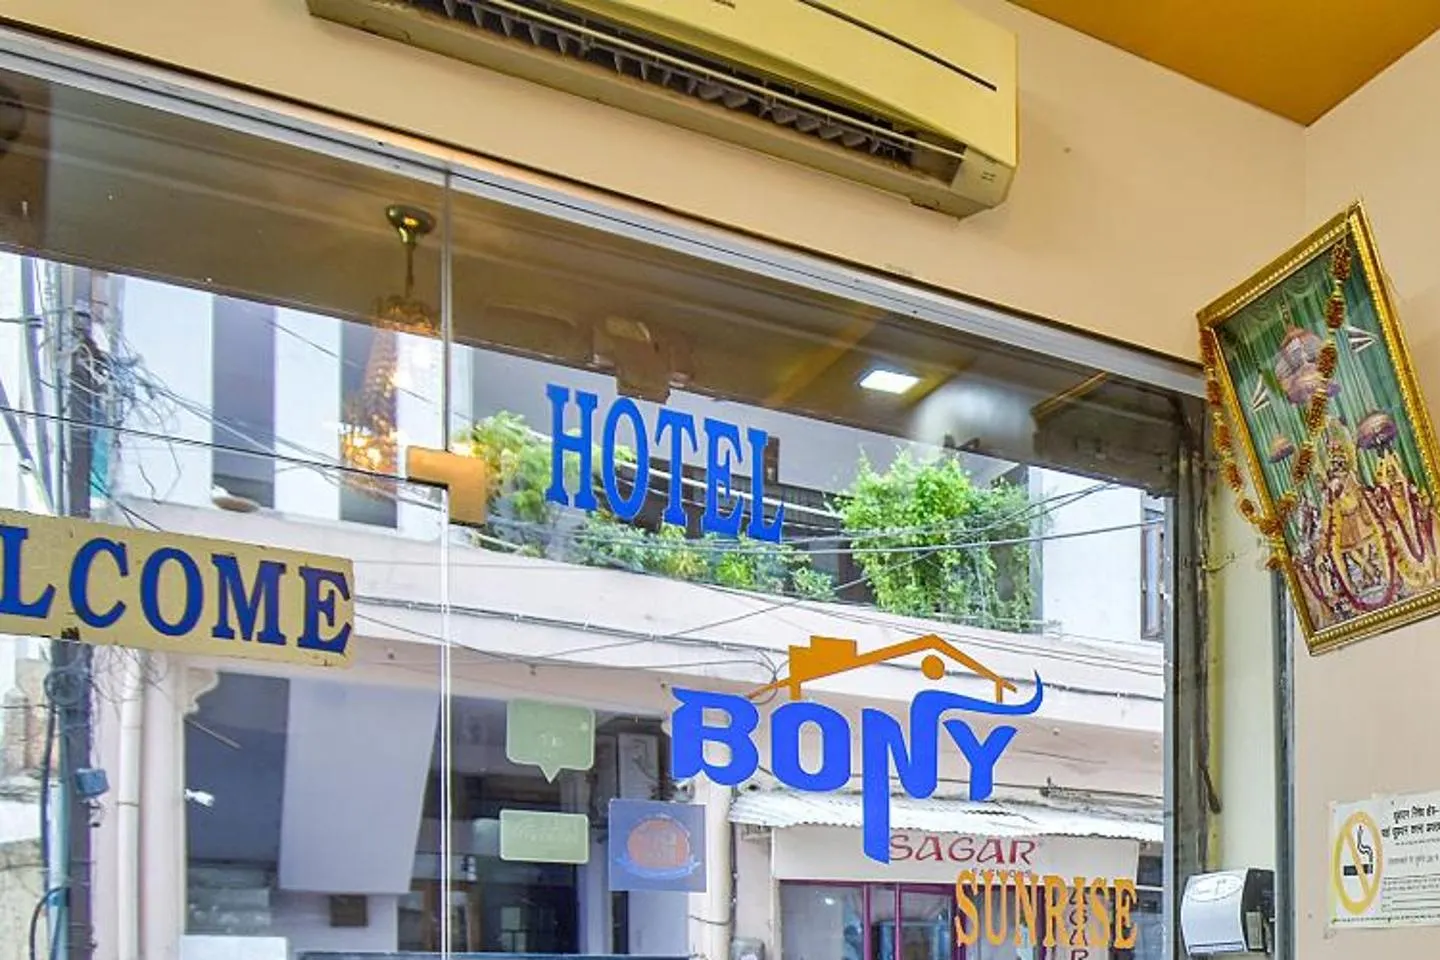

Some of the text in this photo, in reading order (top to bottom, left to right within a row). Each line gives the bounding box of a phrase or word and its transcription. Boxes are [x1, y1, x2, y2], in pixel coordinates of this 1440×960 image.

[545, 383, 785, 544] HOTEL
[0, 523, 353, 655] LCOME
[671, 669, 1043, 865] BONY
[889, 834, 1036, 865] SAGAR
[955, 868, 1139, 950] SUNRISE
